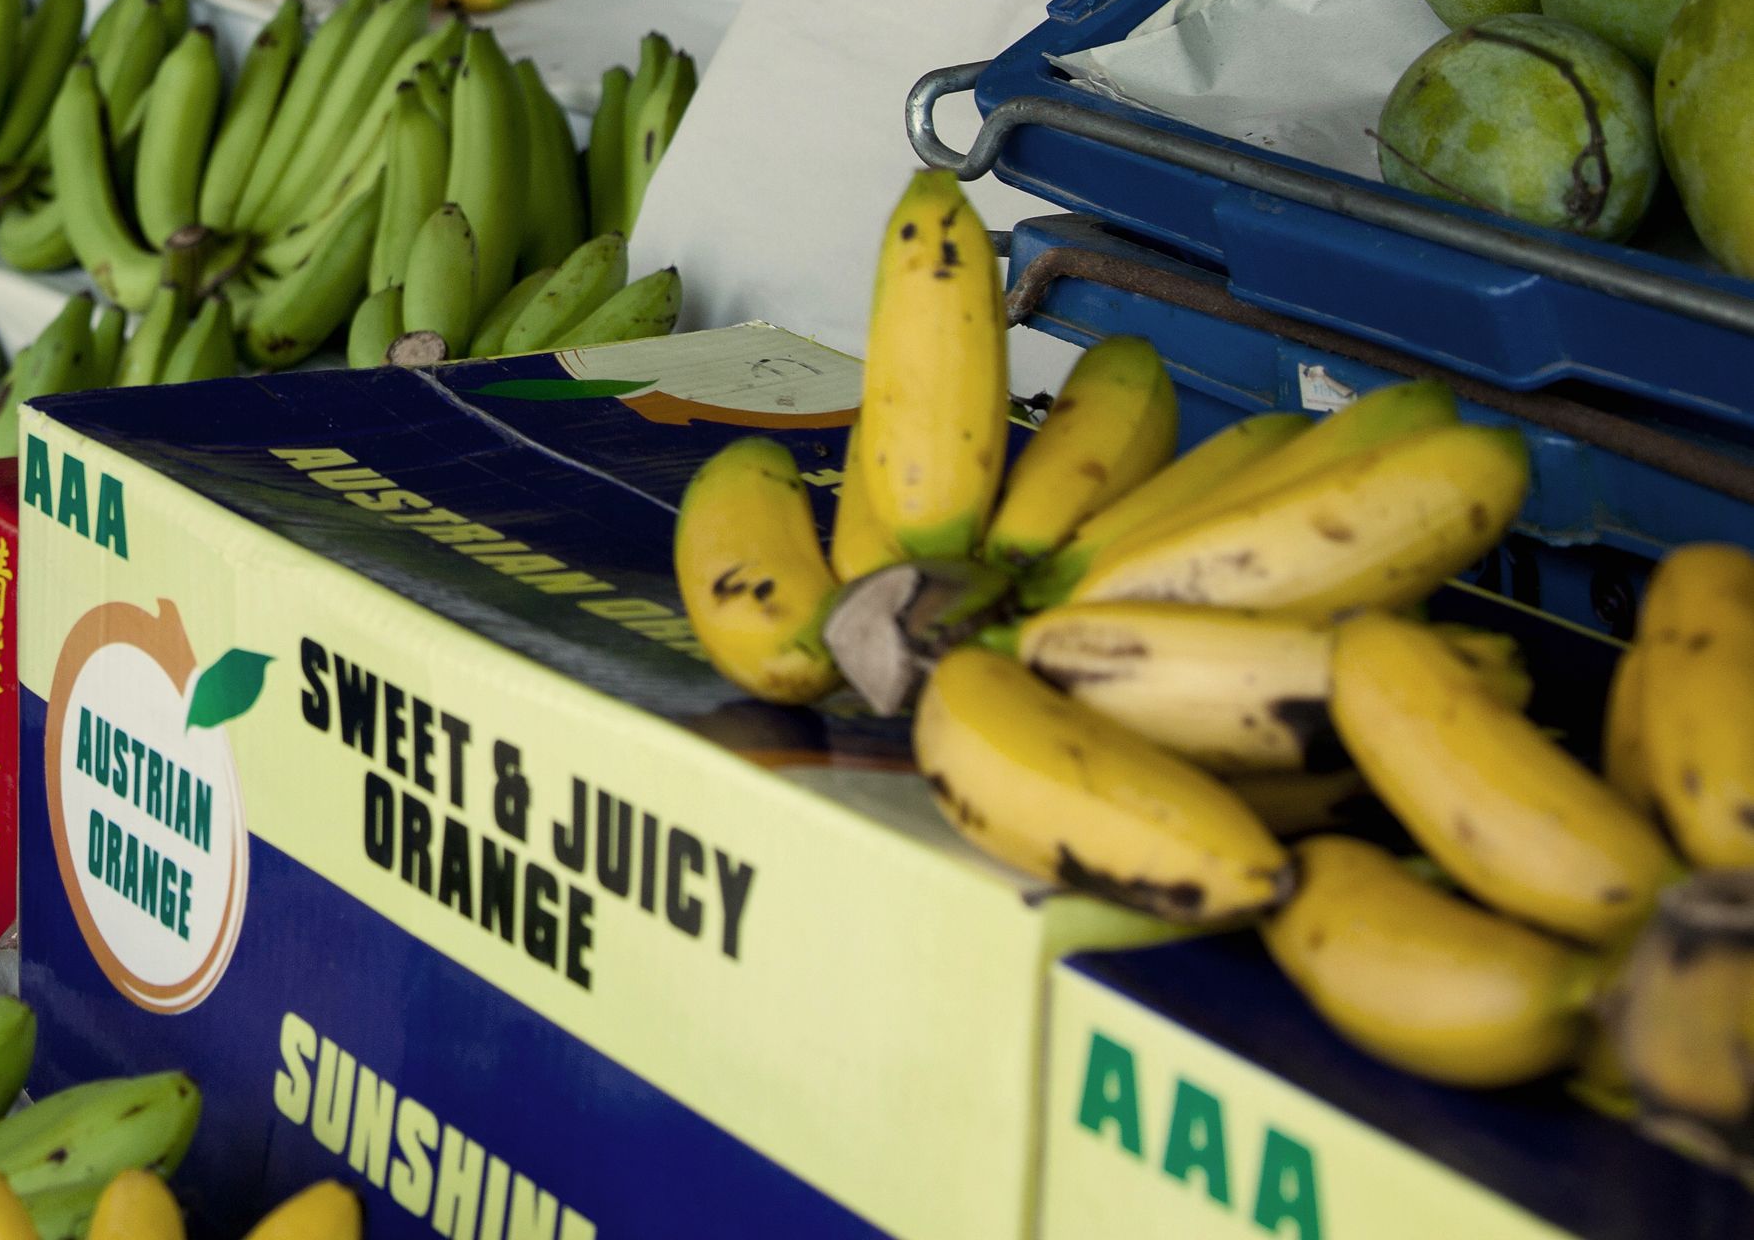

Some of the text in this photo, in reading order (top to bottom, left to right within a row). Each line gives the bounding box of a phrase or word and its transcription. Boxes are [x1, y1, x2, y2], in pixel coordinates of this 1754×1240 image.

[23, 433, 129, 561] AAA
[267, 447, 617, 595] AUSTRIAN
[76, 705, 213, 854] AUSTRIAN
[300, 636, 756, 963] SWEET & JUICY
[87, 808, 193, 942] ORANGE
[363, 770, 595, 993] ORANGE
[273, 1011, 598, 1240] SUNSHIN
[1078, 1028, 1323, 1240] AAA
